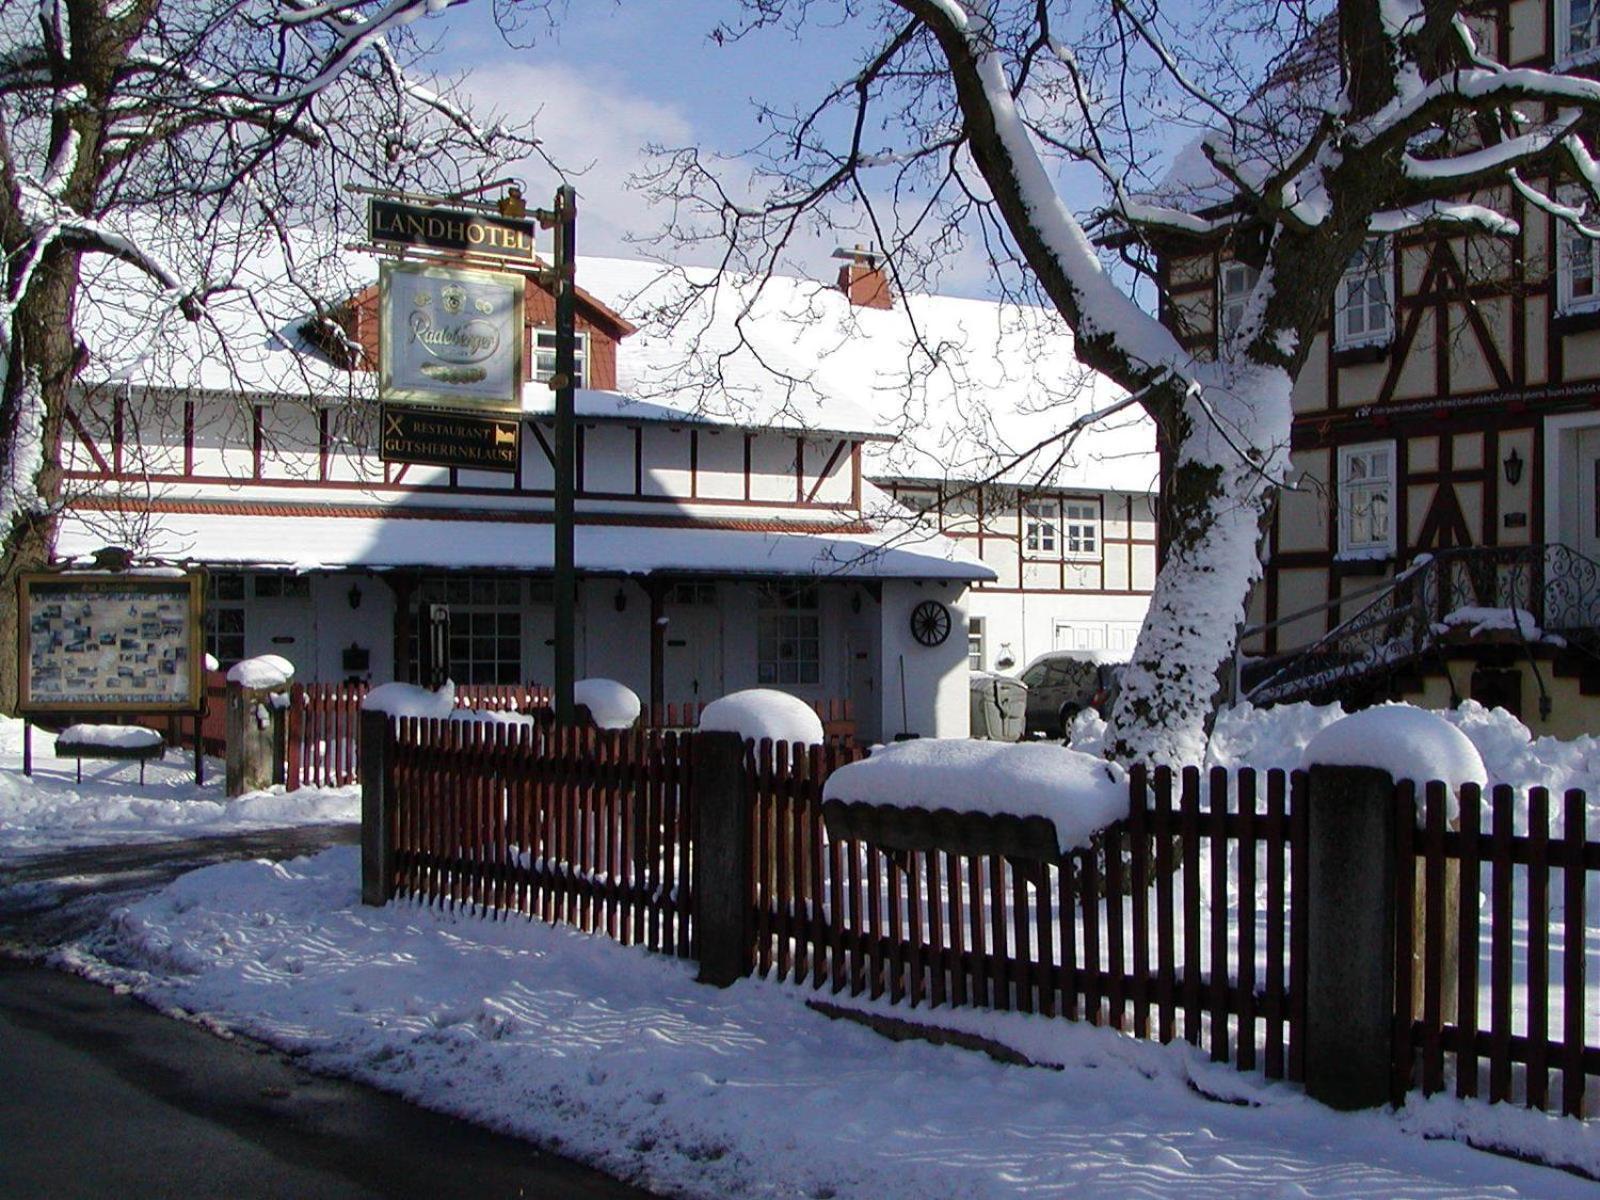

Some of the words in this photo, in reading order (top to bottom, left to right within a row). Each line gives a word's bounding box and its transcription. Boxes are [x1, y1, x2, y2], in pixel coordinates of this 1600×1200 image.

[375, 210, 531, 249] LANDHOTEL
[408, 311, 493, 358] Radeberger
[413, 421, 491, 439] RESTAURANT
[385, 438, 514, 462] GUTSHERRNKLAUSE
